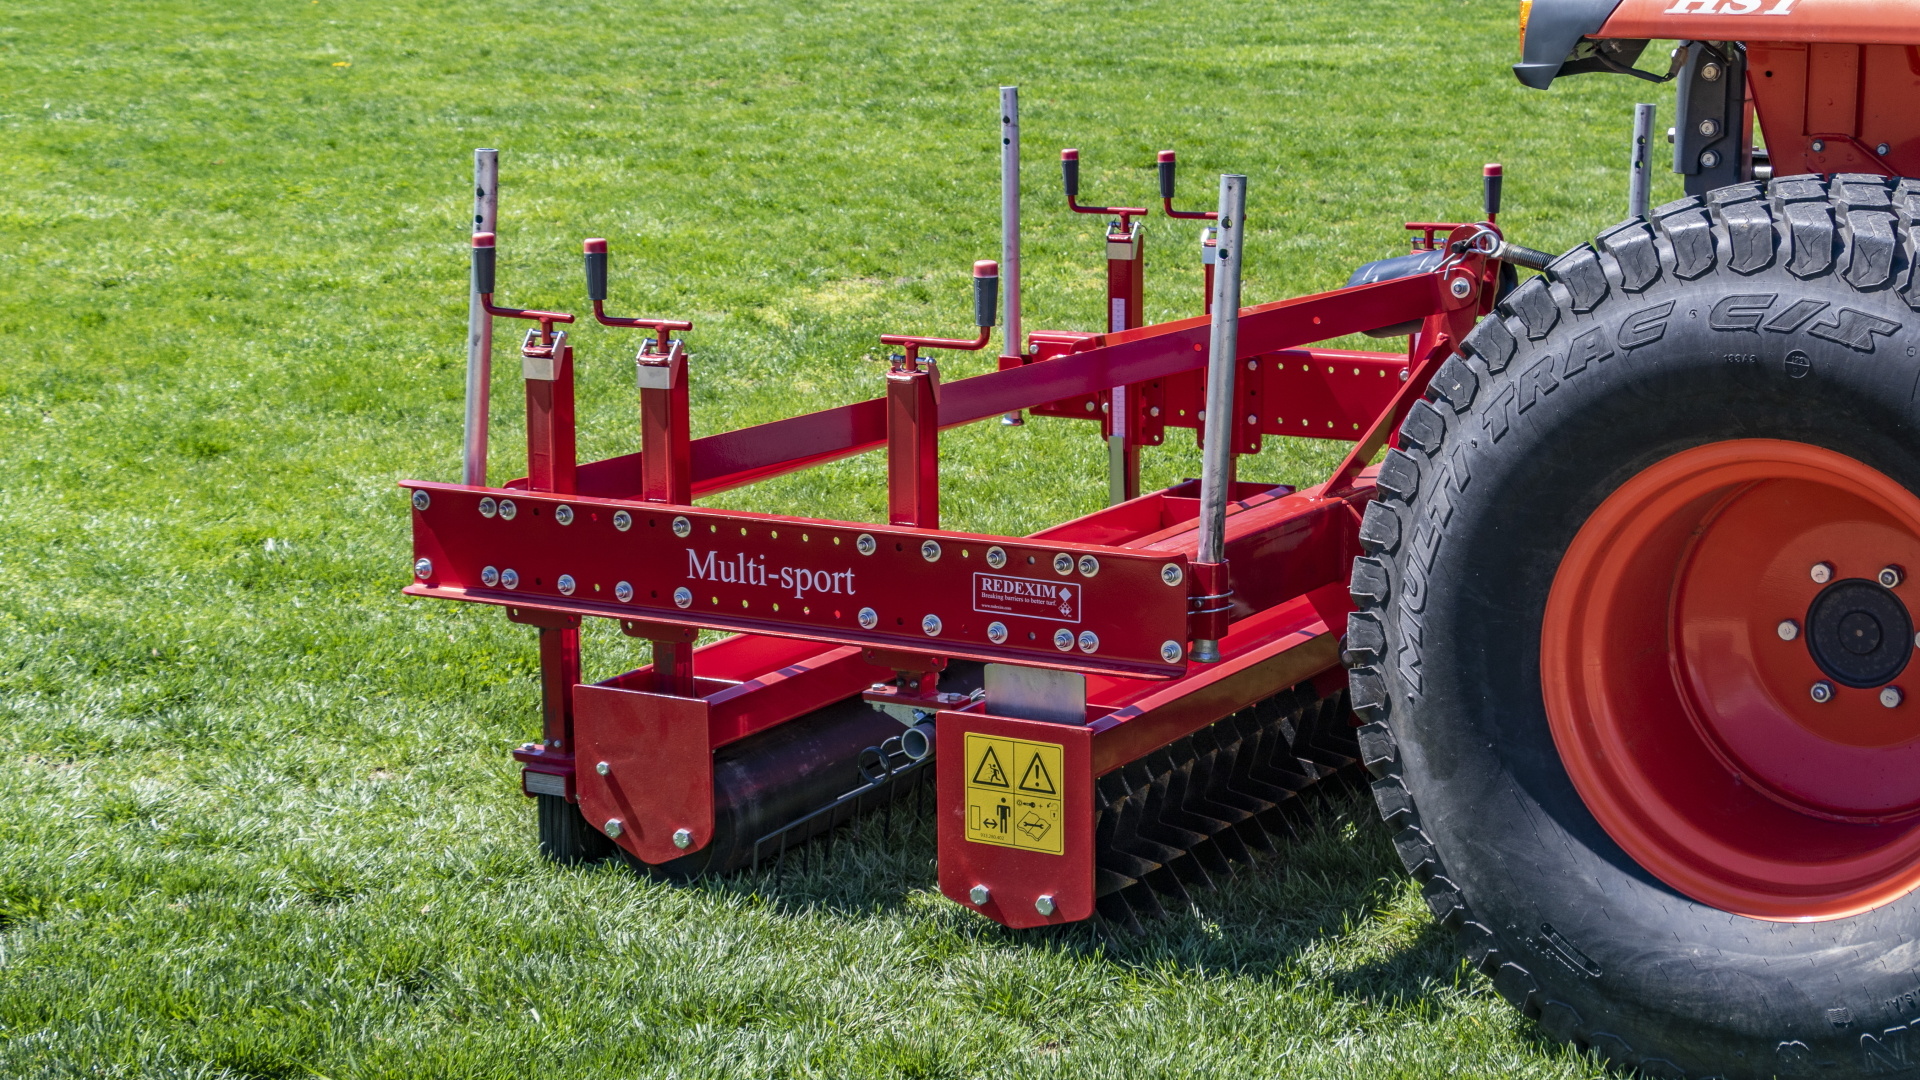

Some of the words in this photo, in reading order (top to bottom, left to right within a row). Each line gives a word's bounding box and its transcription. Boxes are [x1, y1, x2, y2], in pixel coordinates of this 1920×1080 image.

[1398, 441, 1472, 695] MULTI
[1481, 299, 1676, 444] TRAC
[686, 548, 856, 599] Multi-sport
[982, 578, 1057, 599] REDEXIM
[981, 592, 1004, 601] Breaking
[1004, 594, 1023, 602] barriers
